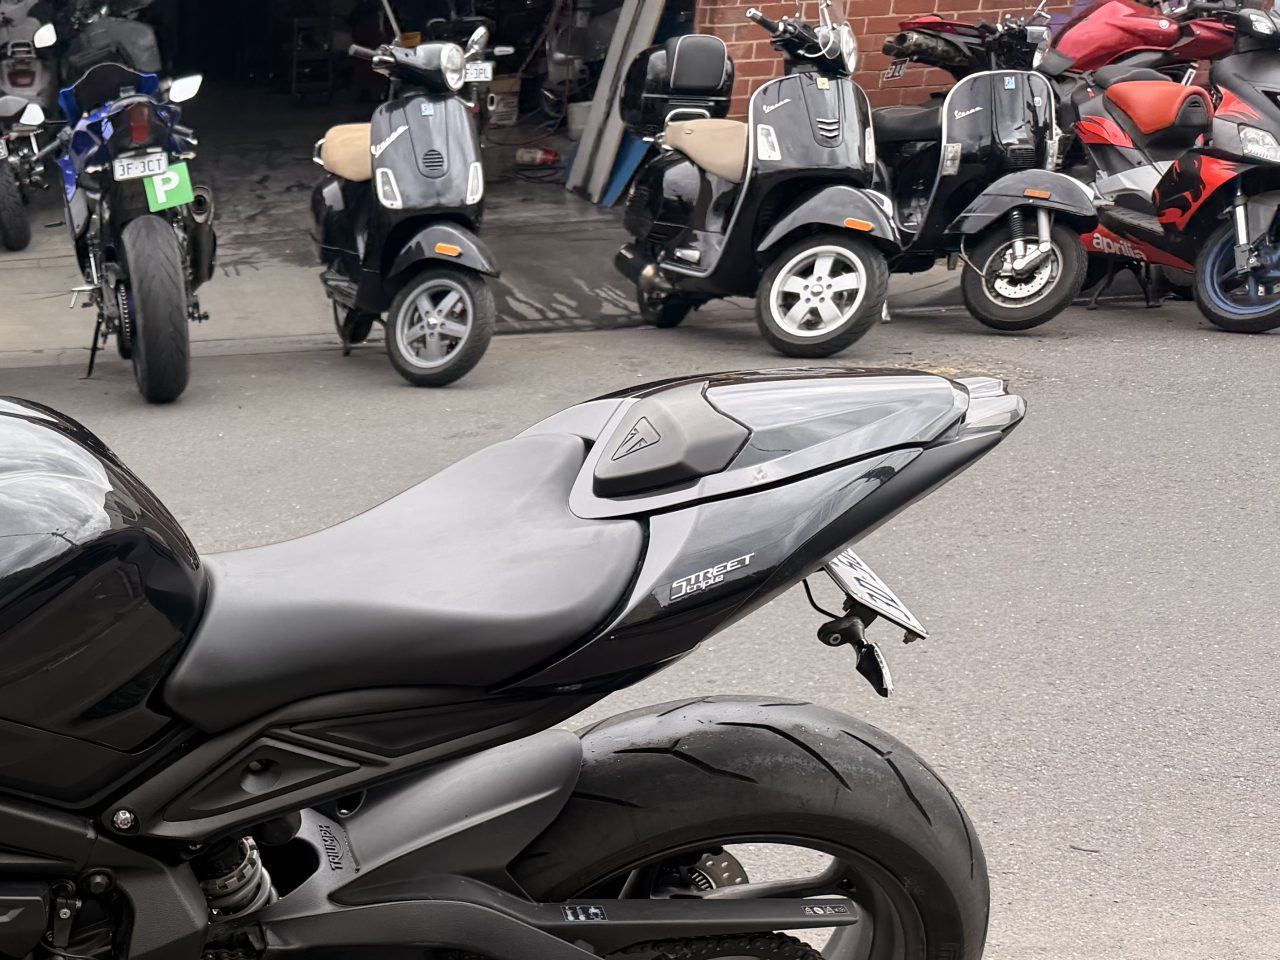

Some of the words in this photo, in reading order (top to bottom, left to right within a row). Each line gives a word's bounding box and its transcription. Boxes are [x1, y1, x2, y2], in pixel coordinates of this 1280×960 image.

[370, 125, 409, 158] Vespa
[152, 171, 180, 204] P
[1092, 232, 1148, 261] aprilia
[670, 552, 755, 600] STREET
[686, 574, 724, 592] triple
[318, 824, 344, 871] TRIUMPH
